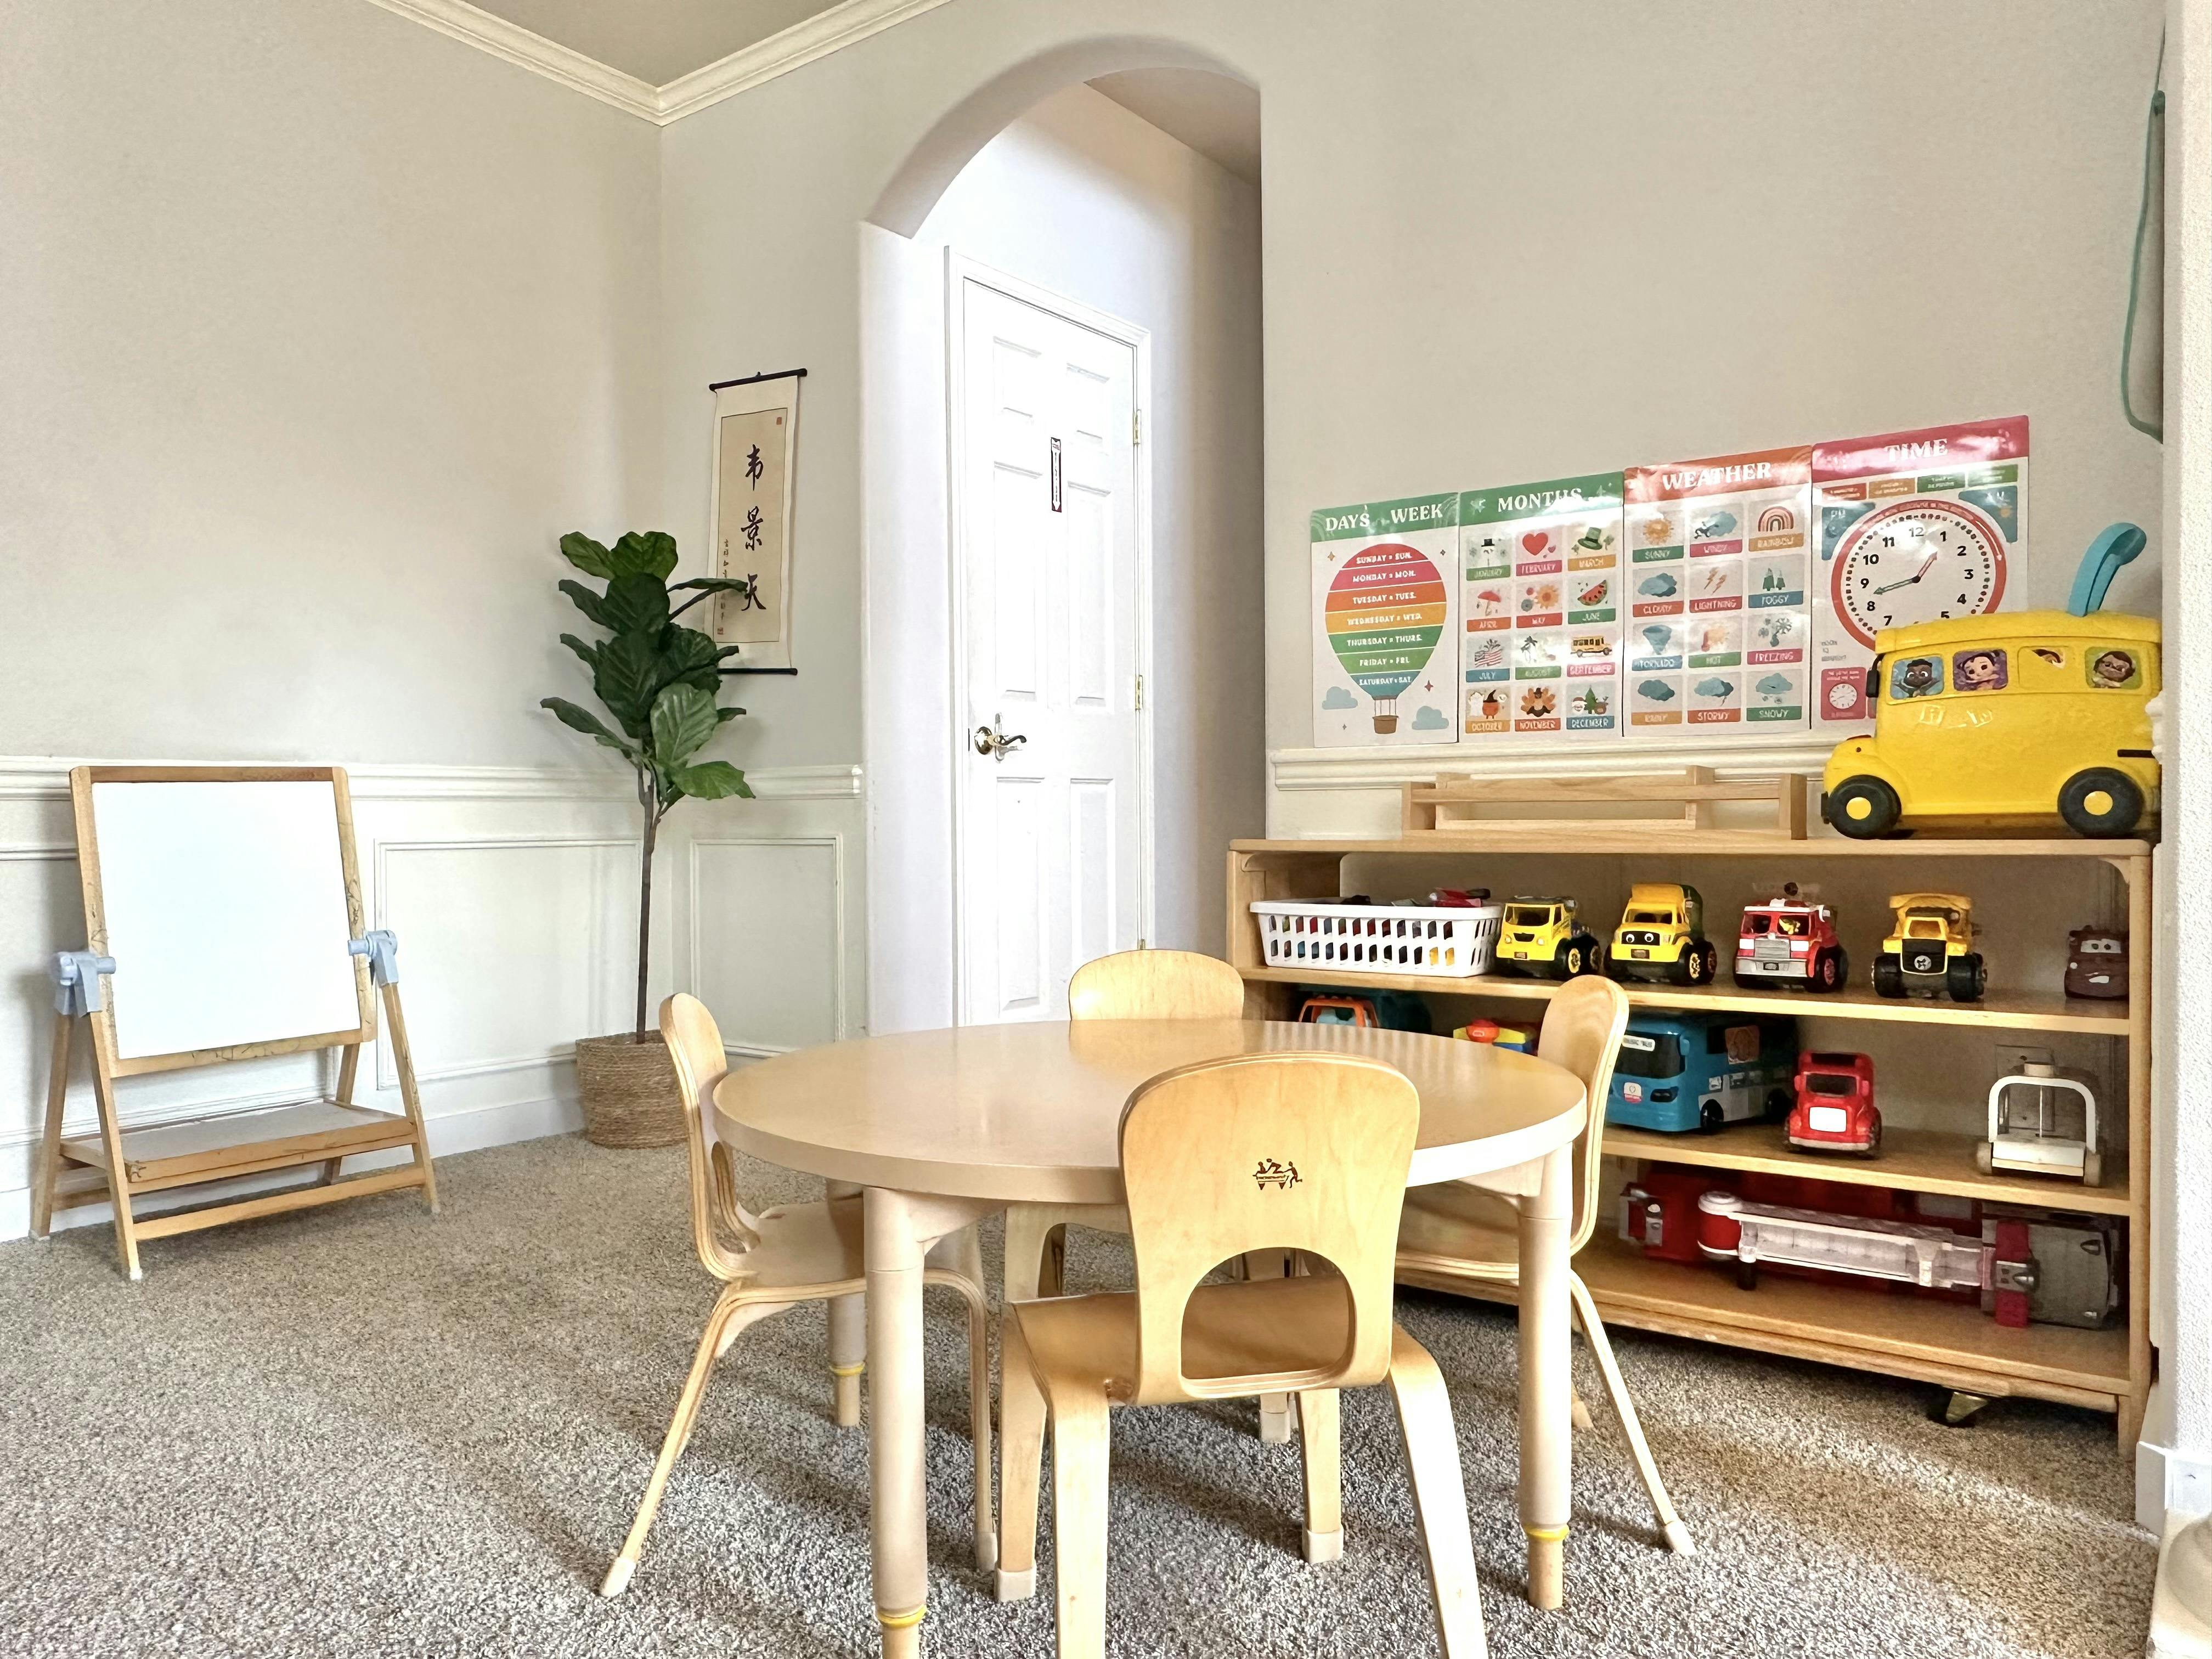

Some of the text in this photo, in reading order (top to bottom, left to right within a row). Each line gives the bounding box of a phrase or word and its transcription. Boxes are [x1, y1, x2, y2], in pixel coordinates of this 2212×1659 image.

[1885, 438, 1949, 462] TIME
[1662, 461, 1771, 490] WEATHER
[1325, 513, 1370, 532] DAYS
[1390, 503, 1443, 524] WEEK
[1909, 527, 1925, 538] 12
[1939, 531, 1947, 542] 1
[1882, 536, 1895, 548] 11
[1956, 545, 1967, 557] 2
[1863, 554, 1880, 566] 10
[1964, 568, 1974, 580] 3
[1860, 578, 1870, 588] 9
[1956, 594, 1967, 605] 4
[1866, 601, 1876, 611] 8
[1883, 614, 1893, 627] 7
